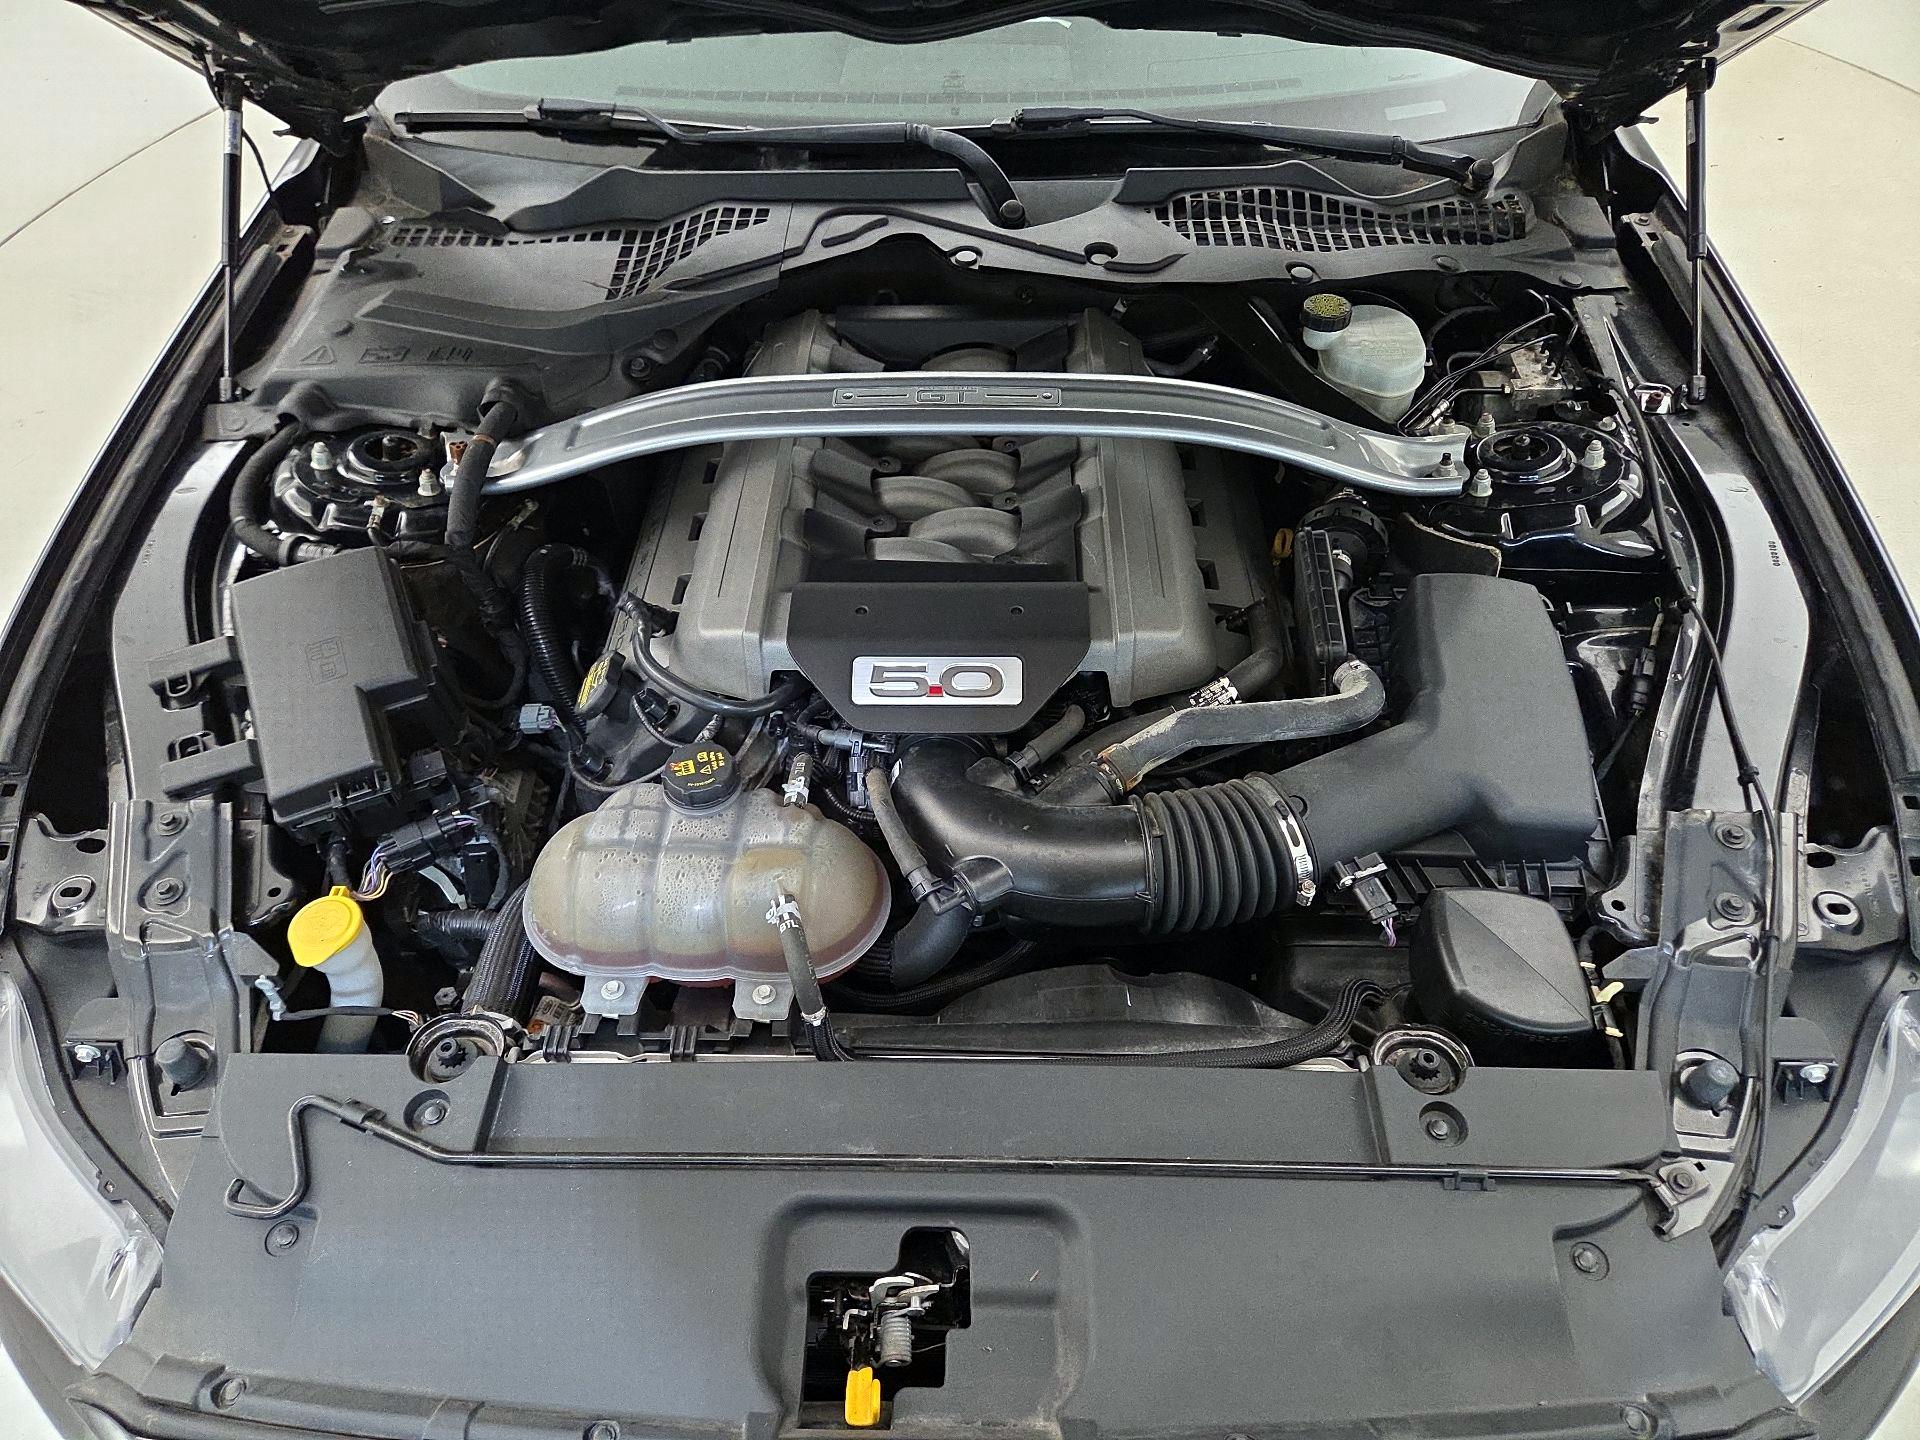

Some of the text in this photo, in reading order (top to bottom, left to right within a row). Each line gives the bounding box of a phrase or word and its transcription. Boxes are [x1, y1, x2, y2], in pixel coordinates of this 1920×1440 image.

[916, 389, 978, 404] GT
[869, 662, 1005, 698] 5.0
[780, 919, 799, 934] BTL
